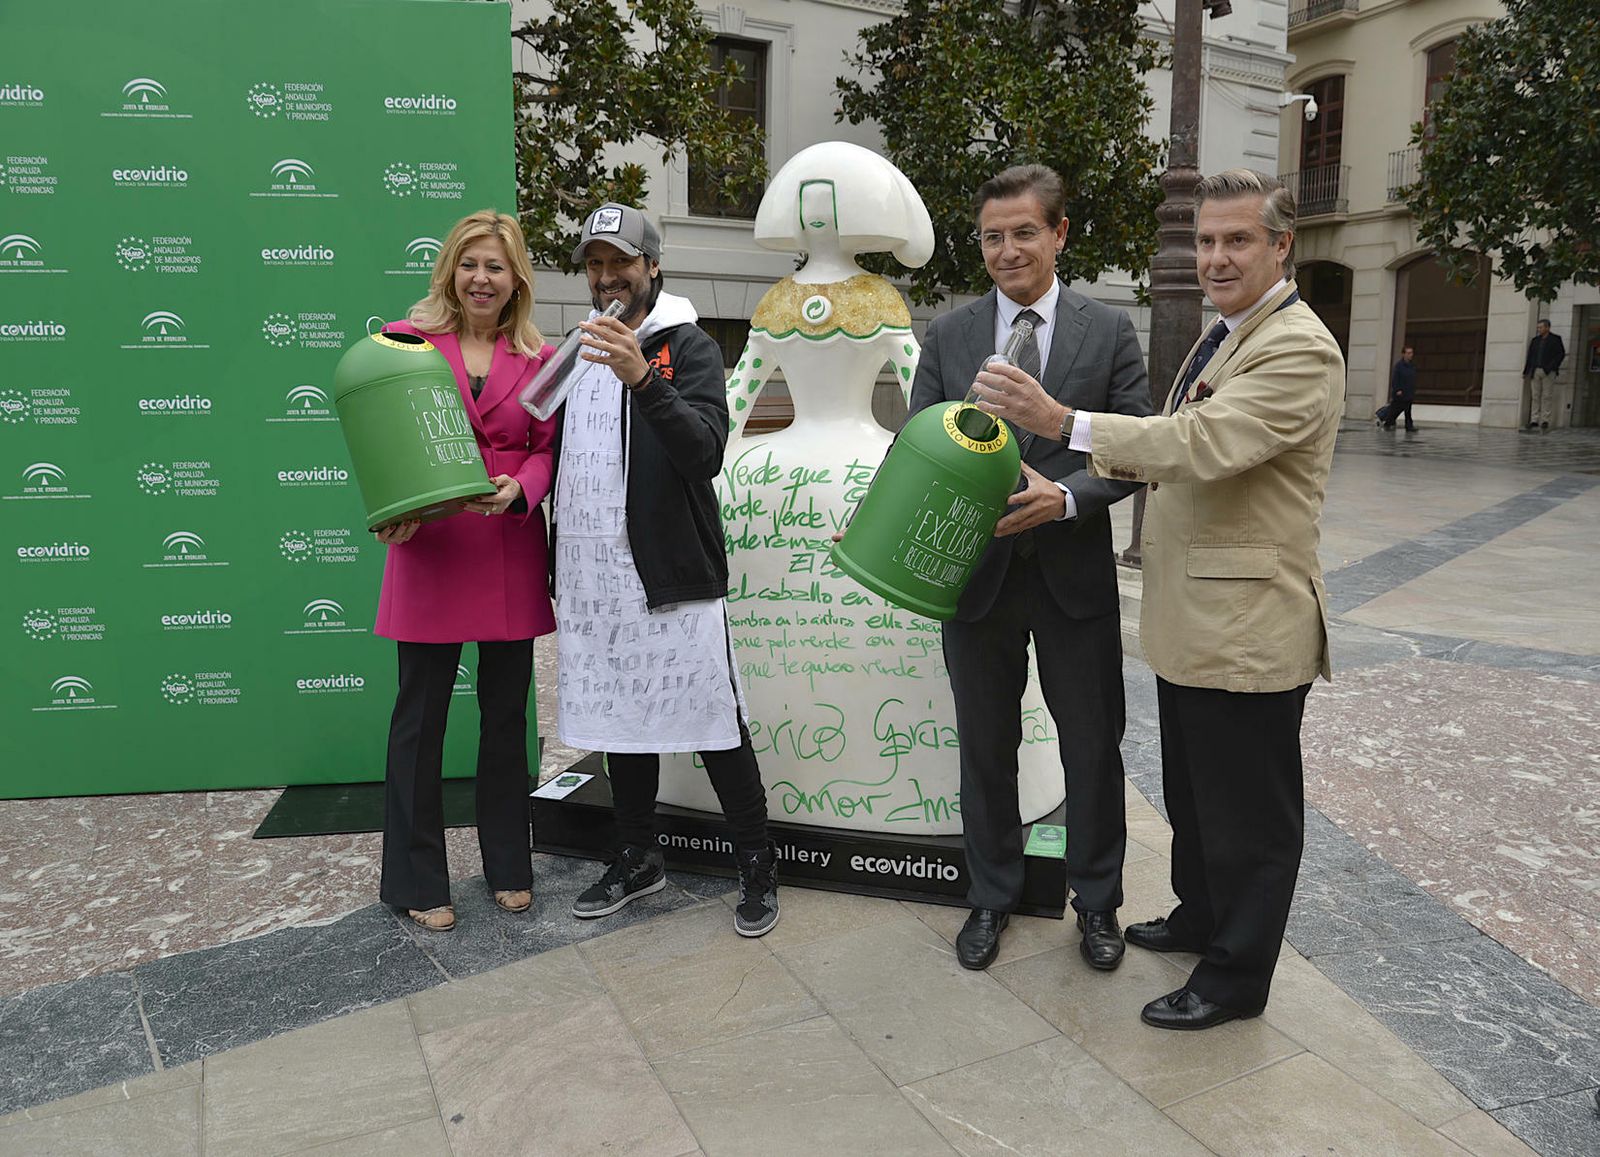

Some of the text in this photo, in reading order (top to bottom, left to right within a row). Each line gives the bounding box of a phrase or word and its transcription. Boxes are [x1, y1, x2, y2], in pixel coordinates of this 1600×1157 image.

[285, 83, 323, 91] FEDERACIÓN
[0, 84, 44, 100] vidrio
[384, 94, 456, 110] ecovidrio
[296, 103, 332, 111] MUNICIPIOS
[286, 112, 329, 120] Y PROVINCIAS
[7, 156, 48, 164] FEDERACIÓN
[420, 163, 457, 171] FEDERACIÓN
[112, 166, 188, 182] ecovidrio
[420, 172, 450, 180] ANDALUZA
[9, 176, 18, 184] DE
[16, 186, 54, 194] PROVINCIAS
[430, 182, 465, 190] MUNICIPIOS
[426, 191, 462, 199] PROVINCIAS
[153, 236, 191, 244] FEDERACIÓN
[154, 246, 185, 254] ANDALUZA
[262, 245, 334, 260] ecovidrio
[164, 256, 201, 264] MUNICIPIOS
[298, 312, 336, 320] FEDERACIÓN
[0, 321, 66, 336] covidrio
[31, 388, 70, 396] FEDERACIÓN
[32, 398, 64, 406] ANDALUZA
[139, 394, 211, 410] ecovidrio
[945, 417, 1003, 452] SOLO VIDRIO
[173, 461, 210, 469] FEDERACIÓN
[278, 466, 348, 481] ecovidrio
[723, 442, 784, 501] Verde
[782, 466, 832, 510] que
[844, 458, 876, 486] te
[773, 496, 826, 535] Verde
[947, 496, 983, 529] NO HAY
[314, 528, 350, 536] FEDERACIÓN
[915, 510, 984, 560] EXCUSAS
[17, 542, 90, 557] ecovidrio
[325, 546, 359, 554] MUNICIPIOS
[903, 545, 941, 576] RECICLA
[758, 578, 833, 604] caballo
[840, 592, 873, 606] en
[58, 606, 95, 615] FEDERACIÓN
[161, 610, 232, 625] ecovidrio
[70, 624, 105, 632] MUNICIPIOS
[195, 672, 231, 680] FEDERACIÓN
[740, 660, 776, 690] que
[296, 674, 364, 689] ecovidrio
[207, 688, 240, 696] MUNICIPIOS
[751, 694, 847, 762] erico
[654, 831, 733, 854] omenin
[850, 853, 959, 882] ecovidrio
